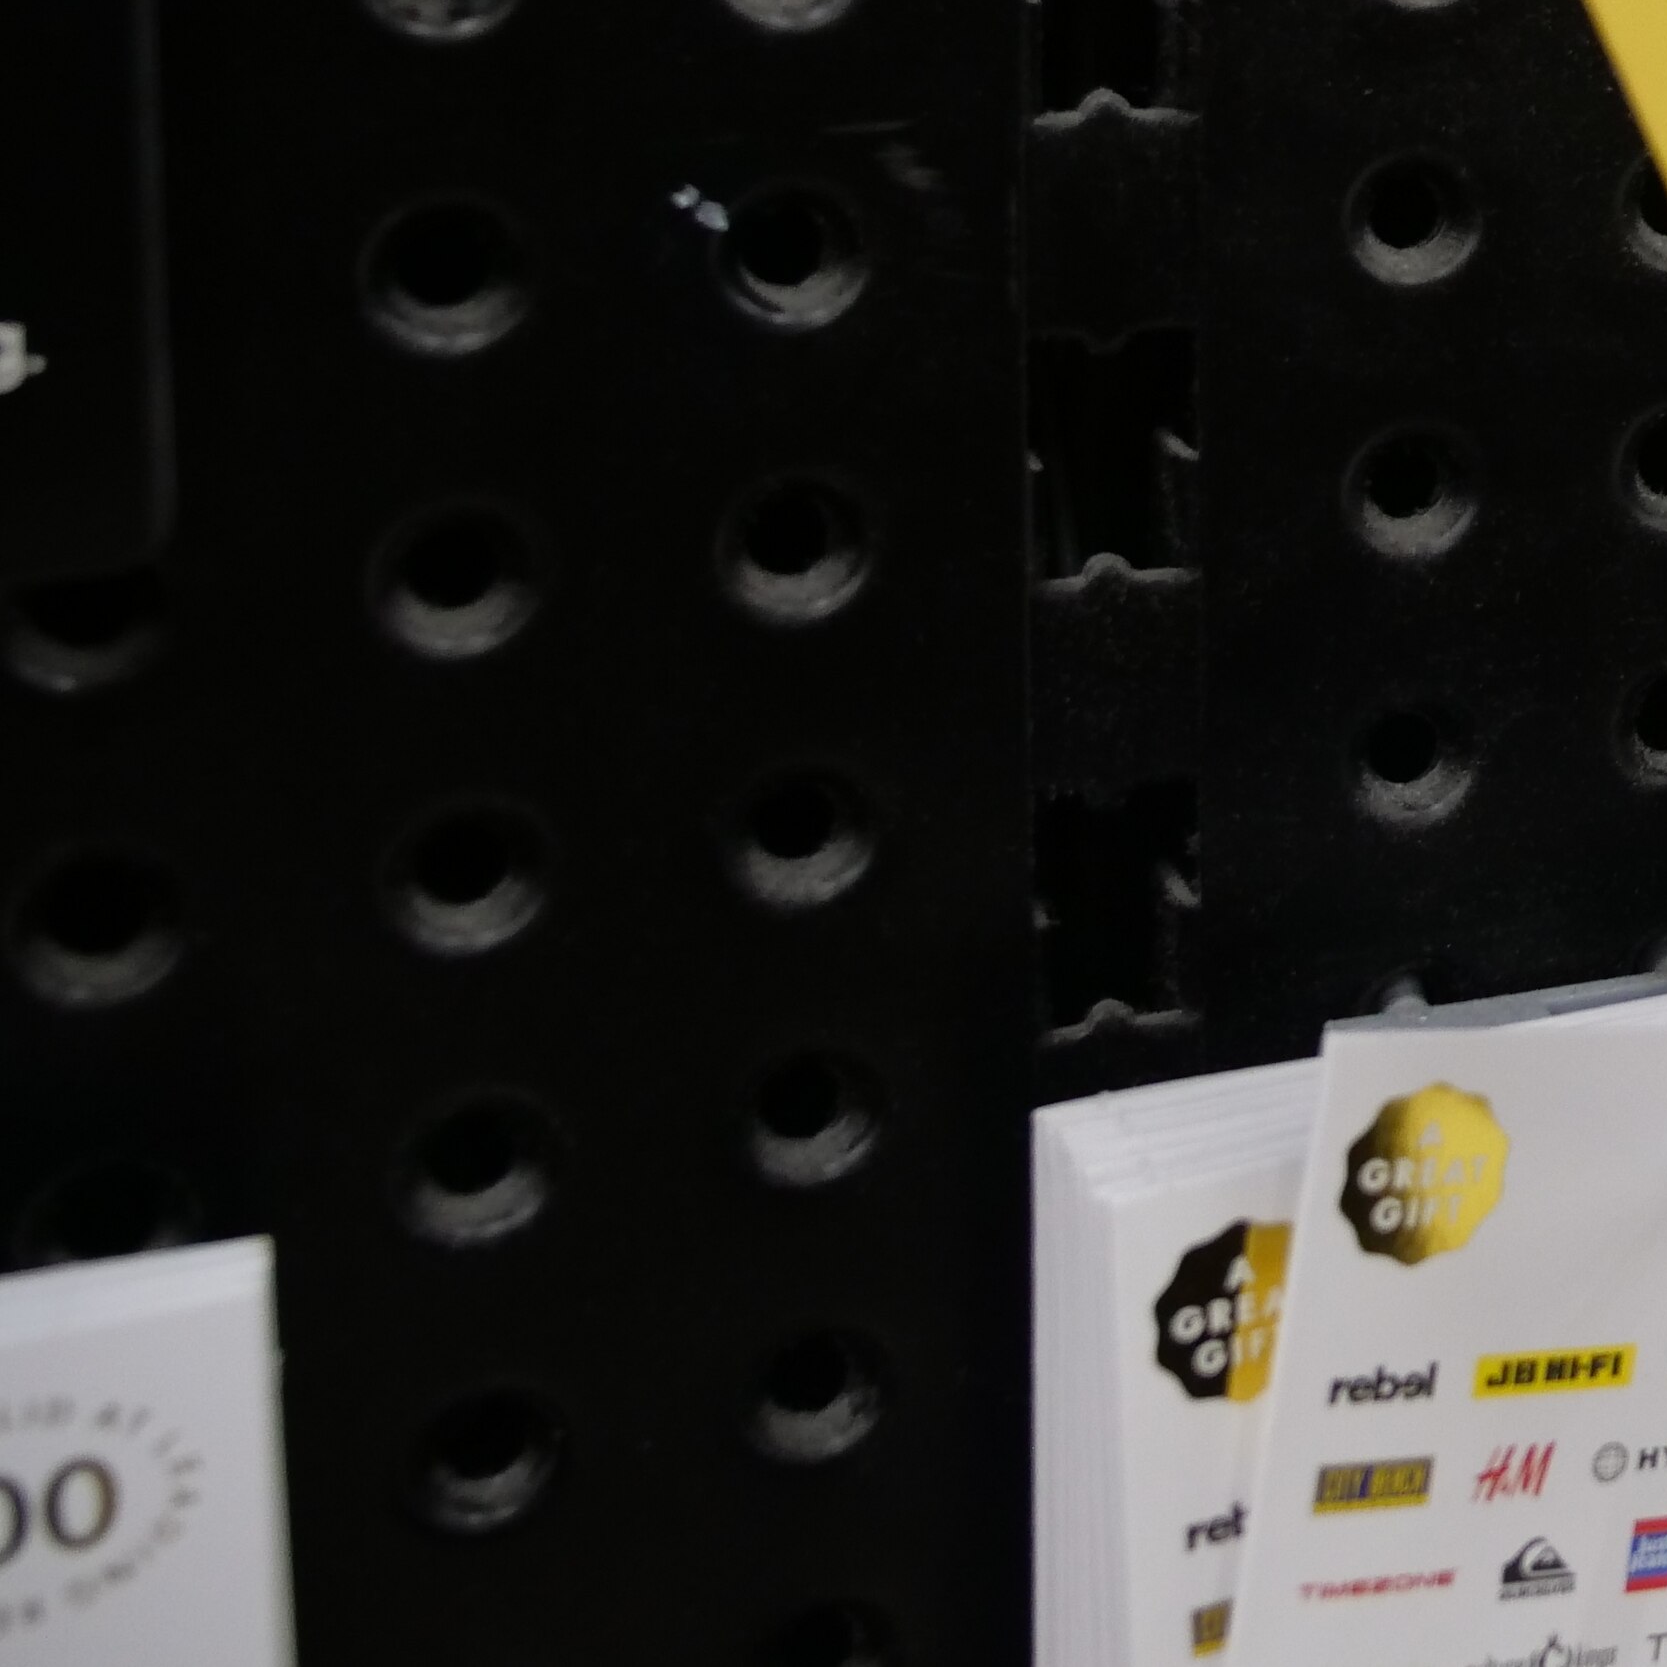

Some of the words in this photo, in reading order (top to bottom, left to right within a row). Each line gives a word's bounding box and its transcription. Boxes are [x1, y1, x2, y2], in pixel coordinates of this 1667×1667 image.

[1417, 1119, 1444, 1149] A
[1357, 1153, 1489, 1196] GREAT
[1370, 1194, 1464, 1234] GIFT
[1223, 1255, 1255, 1293] A
[1169, 1285, 1283, 1346] GREA
[1191, 1327, 1265, 1379] GIF
[1327, 1359, 1441, 1406] rebel
[1486, 1360, 1537, 1388] JB
